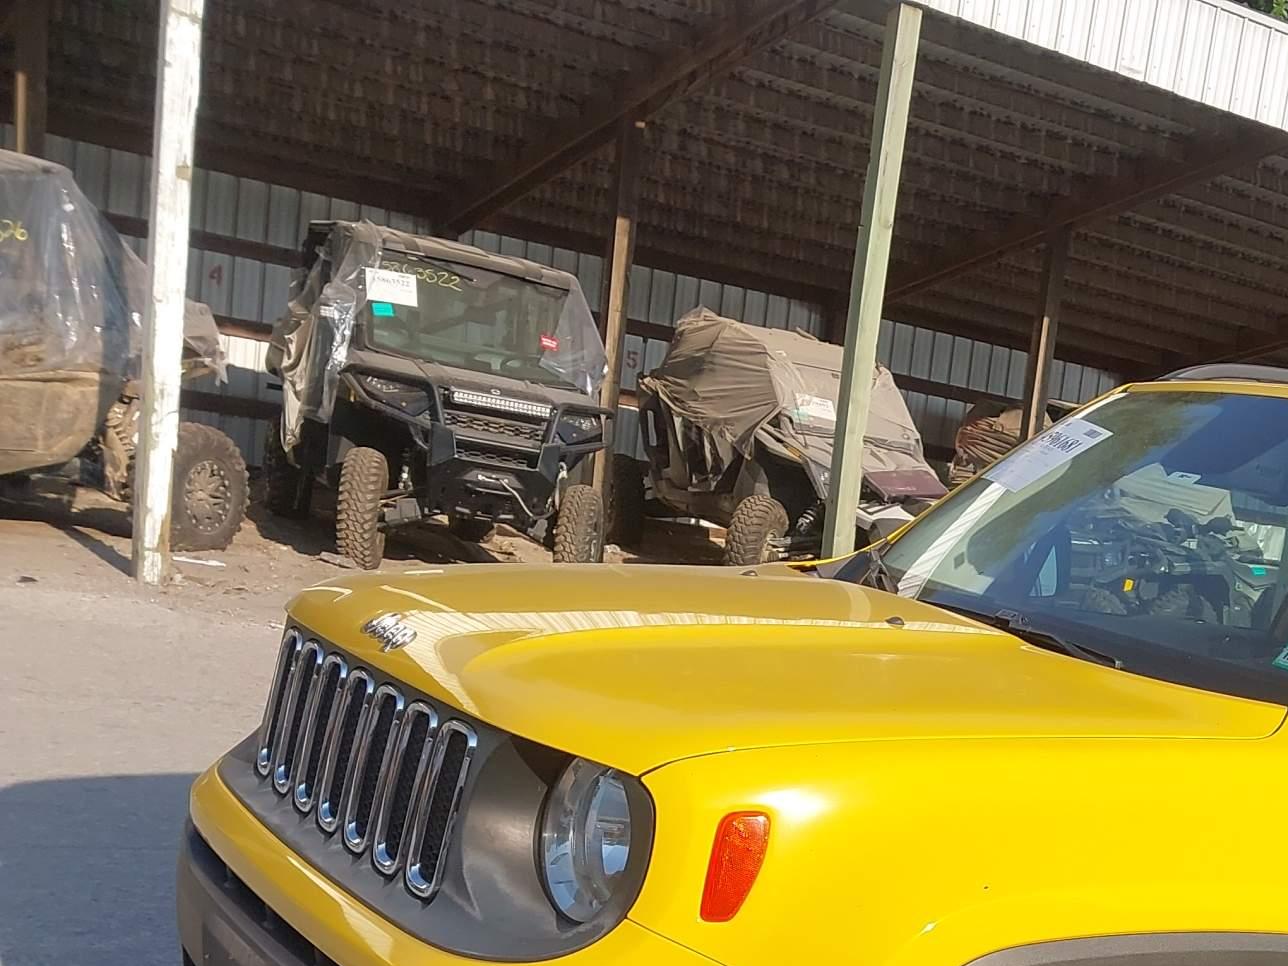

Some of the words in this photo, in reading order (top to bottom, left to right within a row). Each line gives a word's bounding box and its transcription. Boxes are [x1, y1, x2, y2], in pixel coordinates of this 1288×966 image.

[209, 264, 222, 286] 4
[626, 350, 639, 369] 5
[363, 611, 418, 653] Jeep
